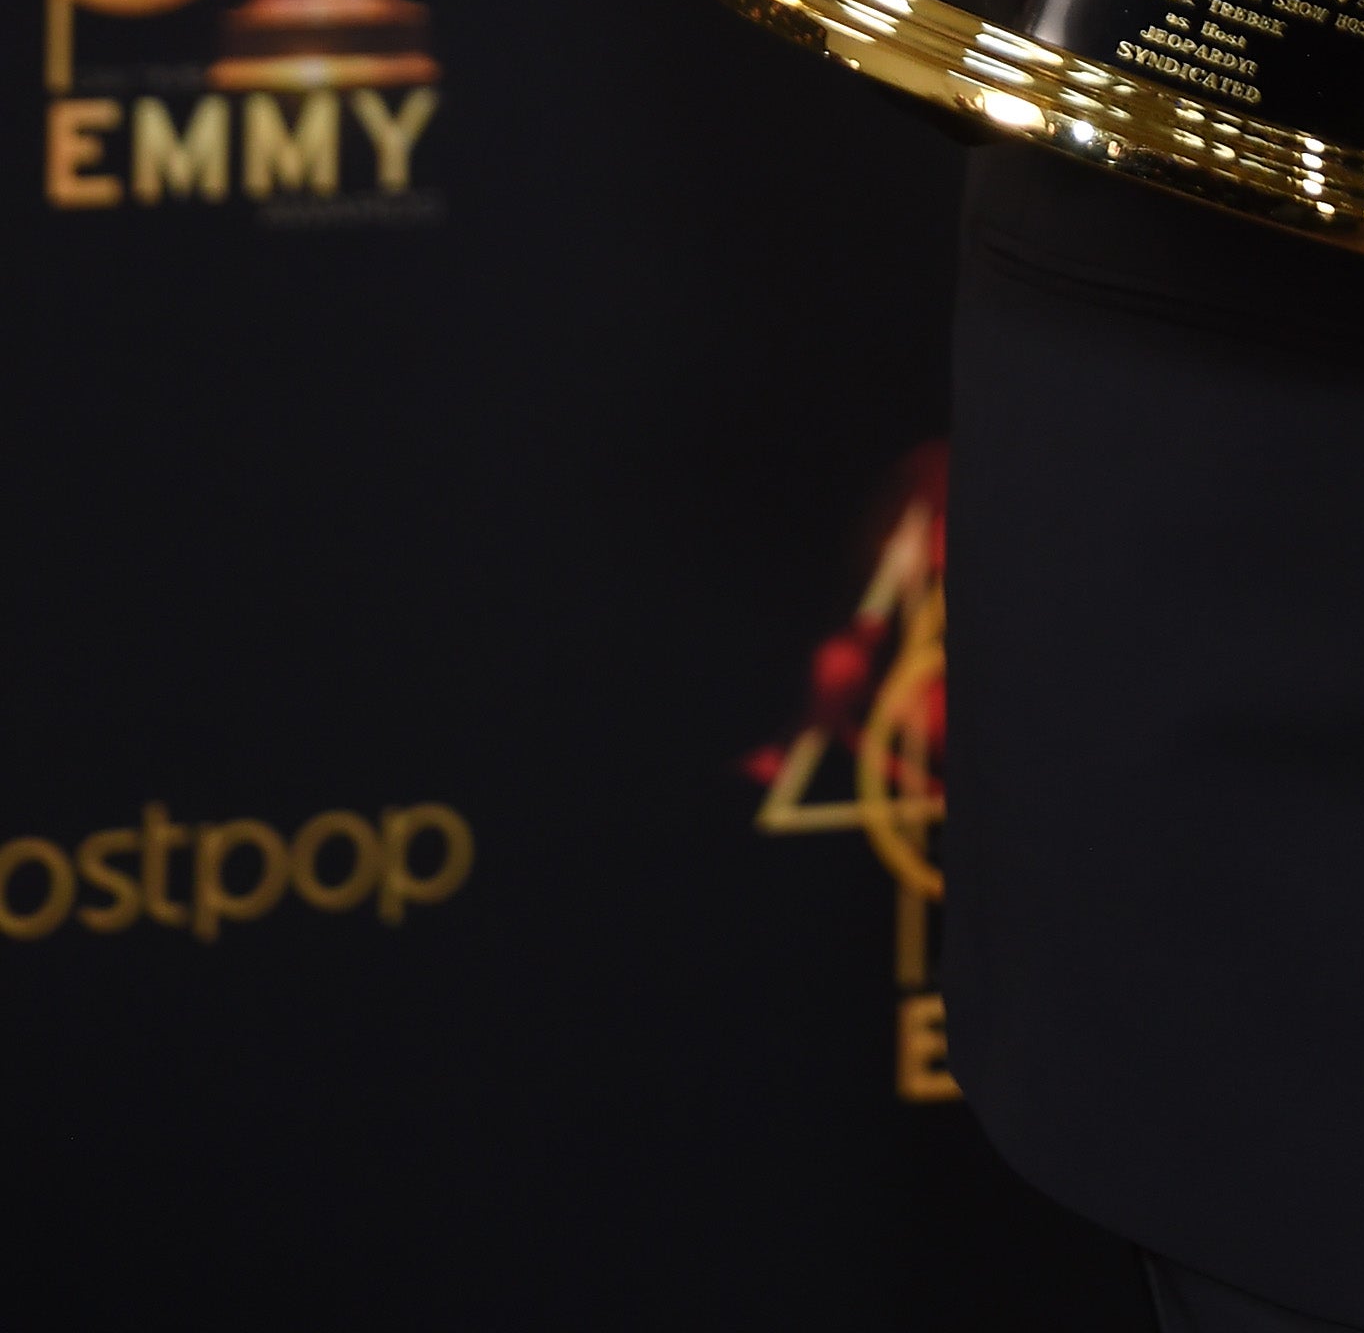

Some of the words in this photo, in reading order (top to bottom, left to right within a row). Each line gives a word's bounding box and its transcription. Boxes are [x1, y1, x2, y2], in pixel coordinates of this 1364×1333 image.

[1116, 40, 1262, 105] SYNDICATED
[45, 88, 440, 209] EMMY
[0, 800, 476, 945] ostpop
